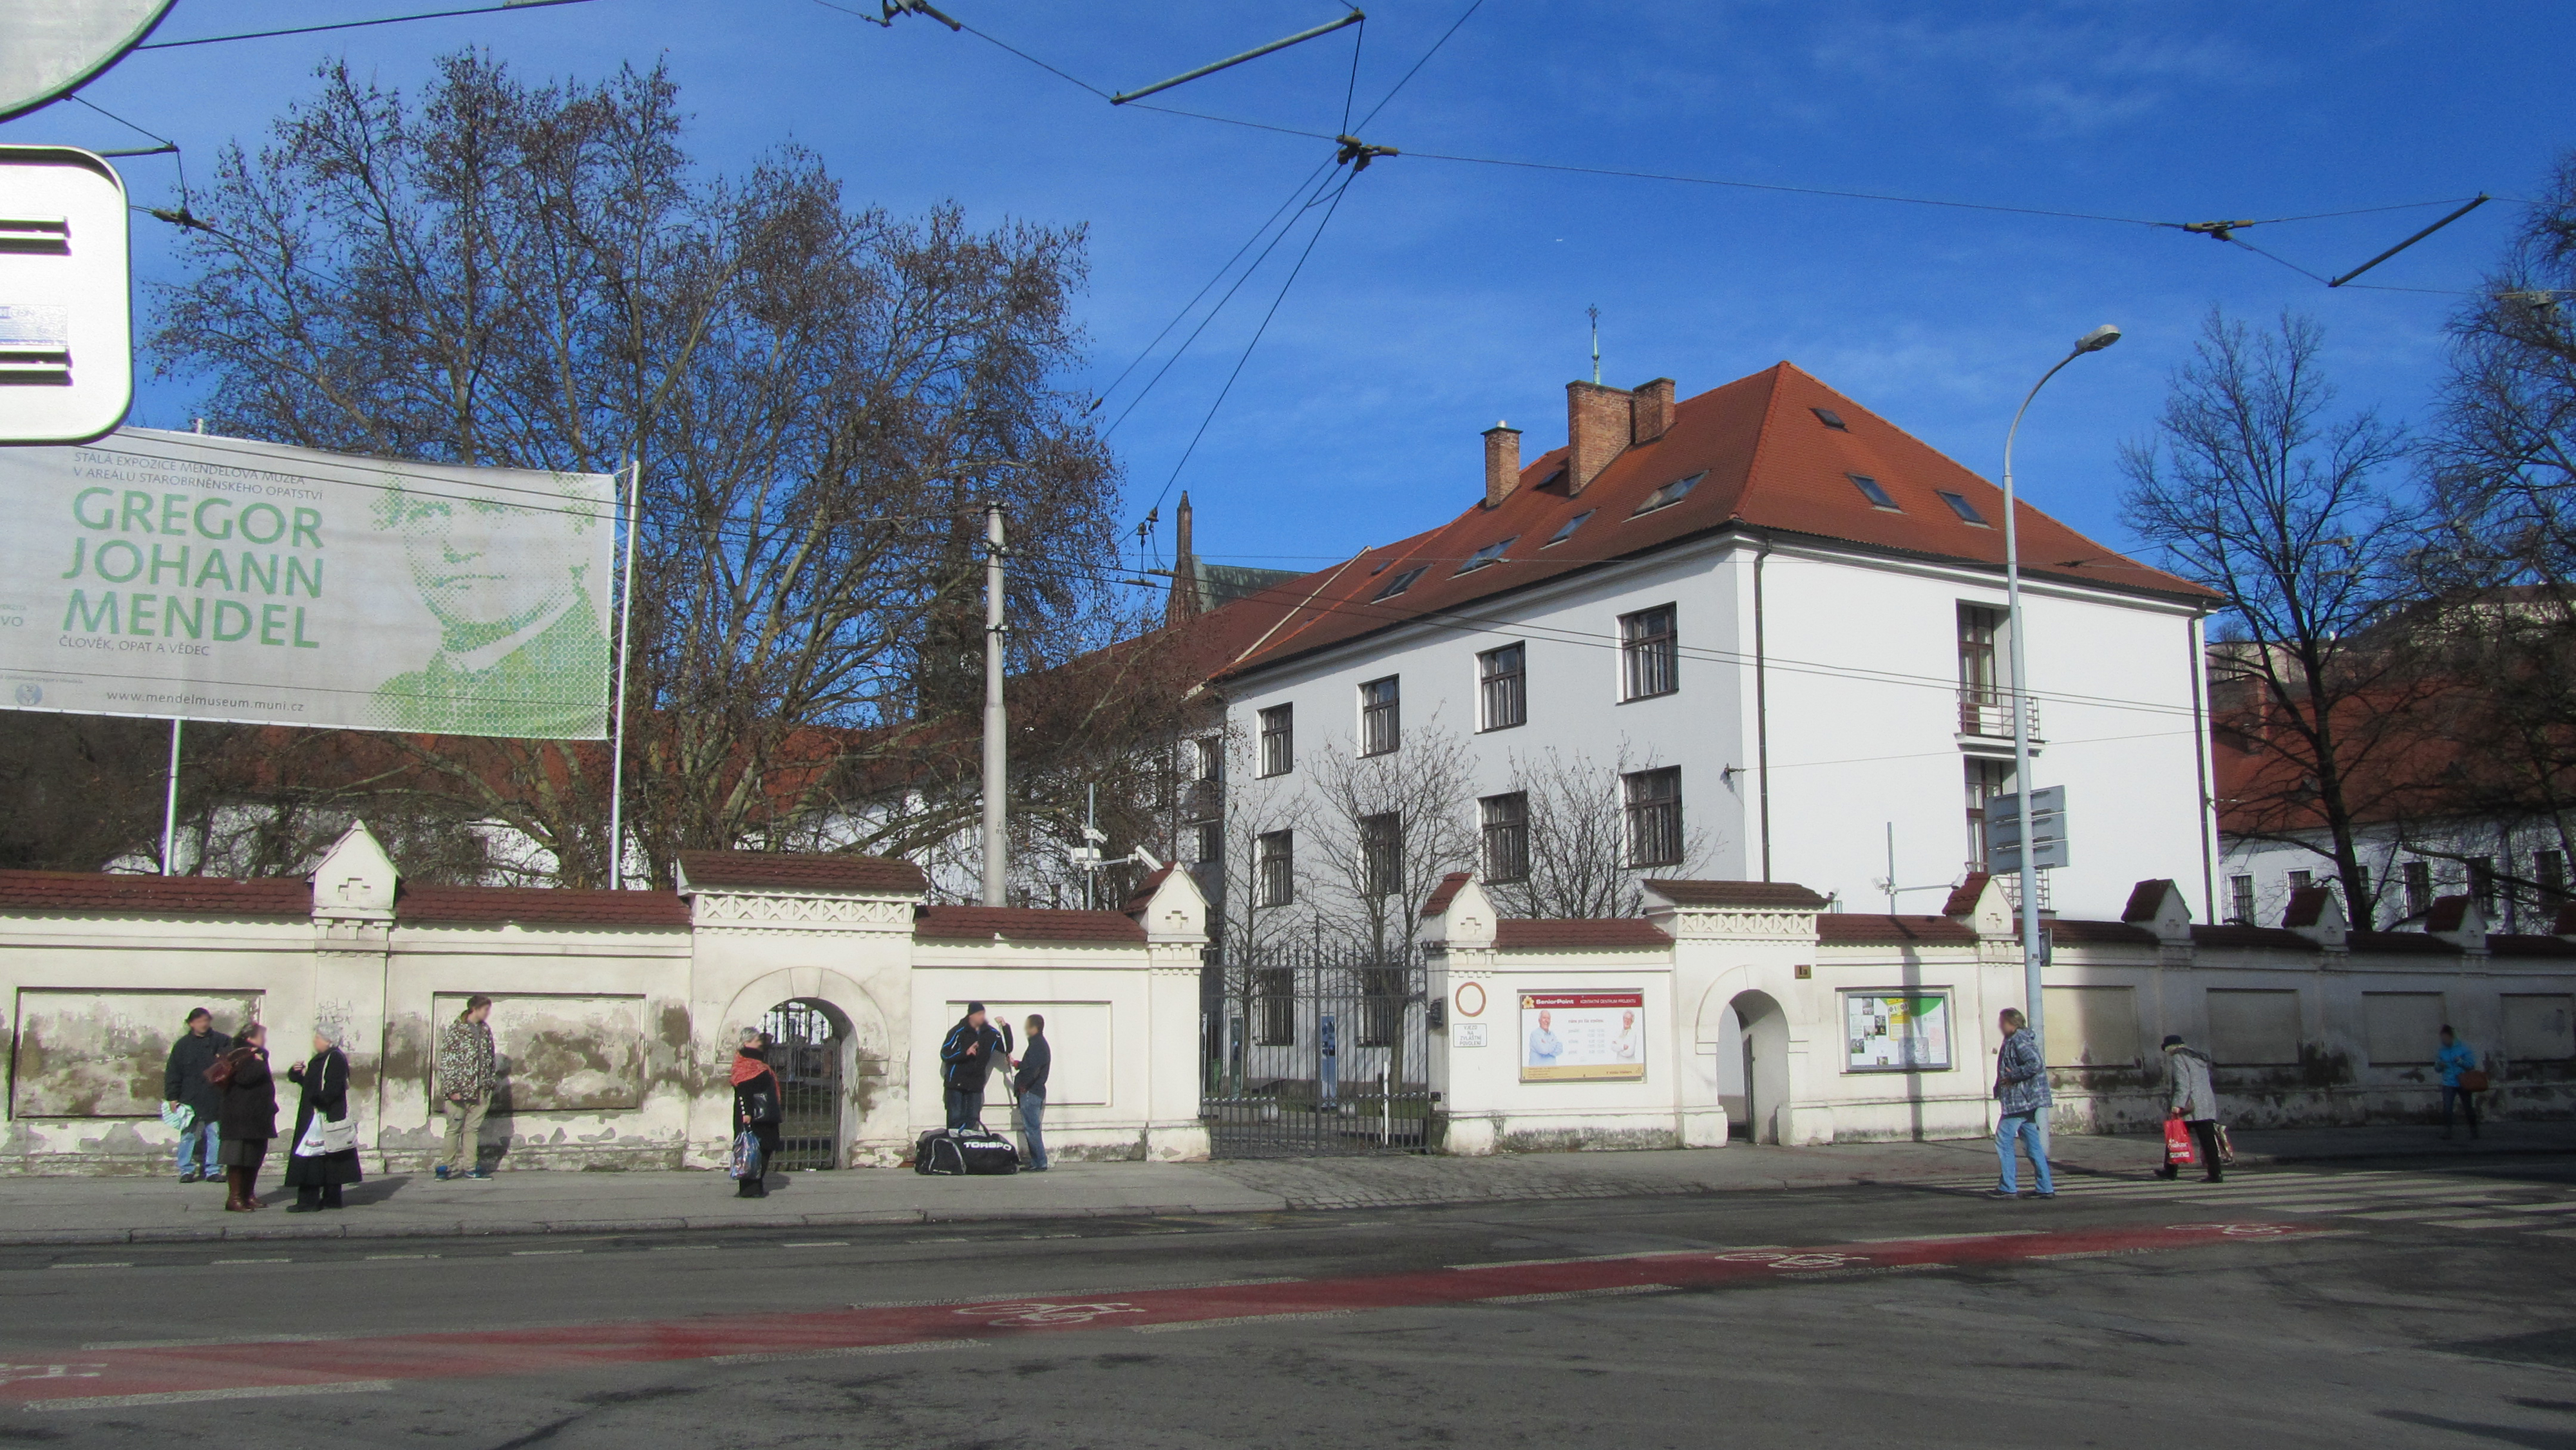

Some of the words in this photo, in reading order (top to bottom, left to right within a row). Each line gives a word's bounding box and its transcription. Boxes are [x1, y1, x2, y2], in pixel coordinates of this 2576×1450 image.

[73, 466, 82, 476] V
[86, 468, 135, 481] AREÁLU
[139, 473, 262, 494] STAROBRNĚNSKÉHO
[266, 486, 323, 500] OPATSTVÍ
[74, 452, 113, 464] STÁLÁ
[116, 456, 176, 471] EXPOZICE
[180, 462, 258, 480] MENDELOVA
[261, 472, 305, 485] MUZEA
[72, 486, 324, 549] GREGOR
[61, 537, 324, 598] JOHANN
[63, 588, 320, 648] MENDEL
[59, 635, 114, 651] ČLOVĚK,
[118, 640, 152, 652] OPAT
[156, 643, 165, 653] A
[170, 643, 210, 656] VĚDEC
[106, 691, 304, 711] www.mendelmuseum.muni.cz
[963, 1142, 1012, 1151] TORSPO
